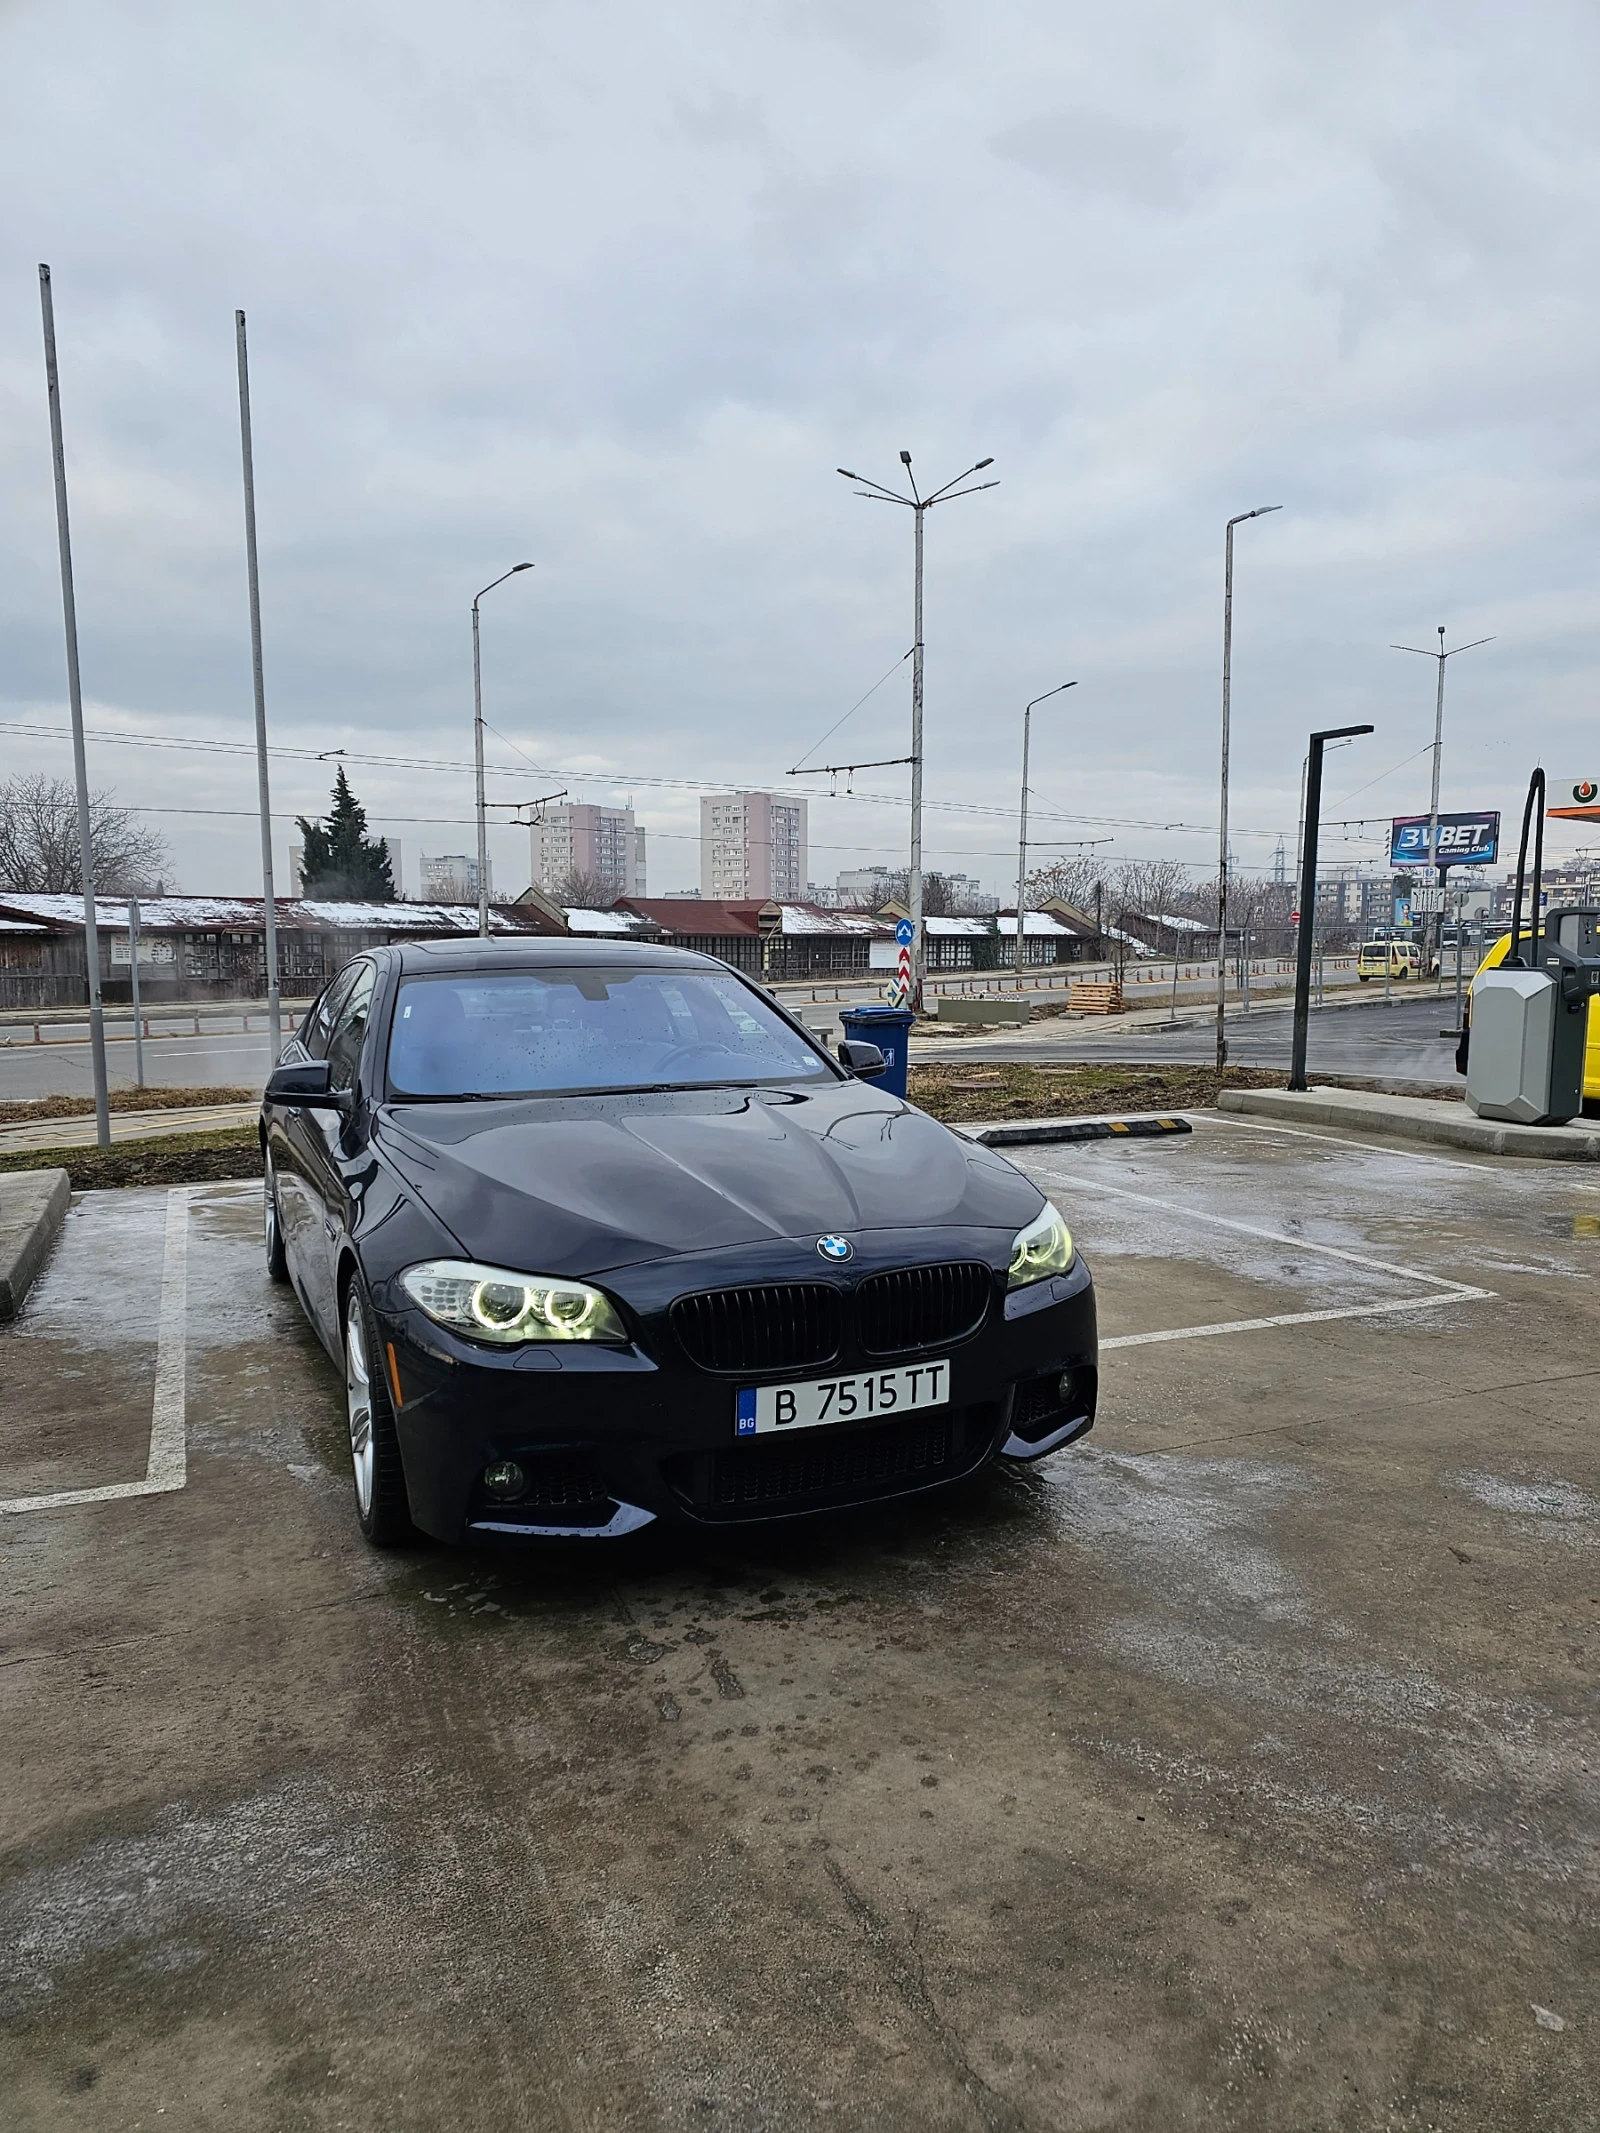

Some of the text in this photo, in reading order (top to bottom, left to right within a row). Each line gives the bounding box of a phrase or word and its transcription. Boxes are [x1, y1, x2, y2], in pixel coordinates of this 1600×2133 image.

[775, 1364, 945, 1425] B 7515 TT
[739, 1417, 755, 1430] BG
